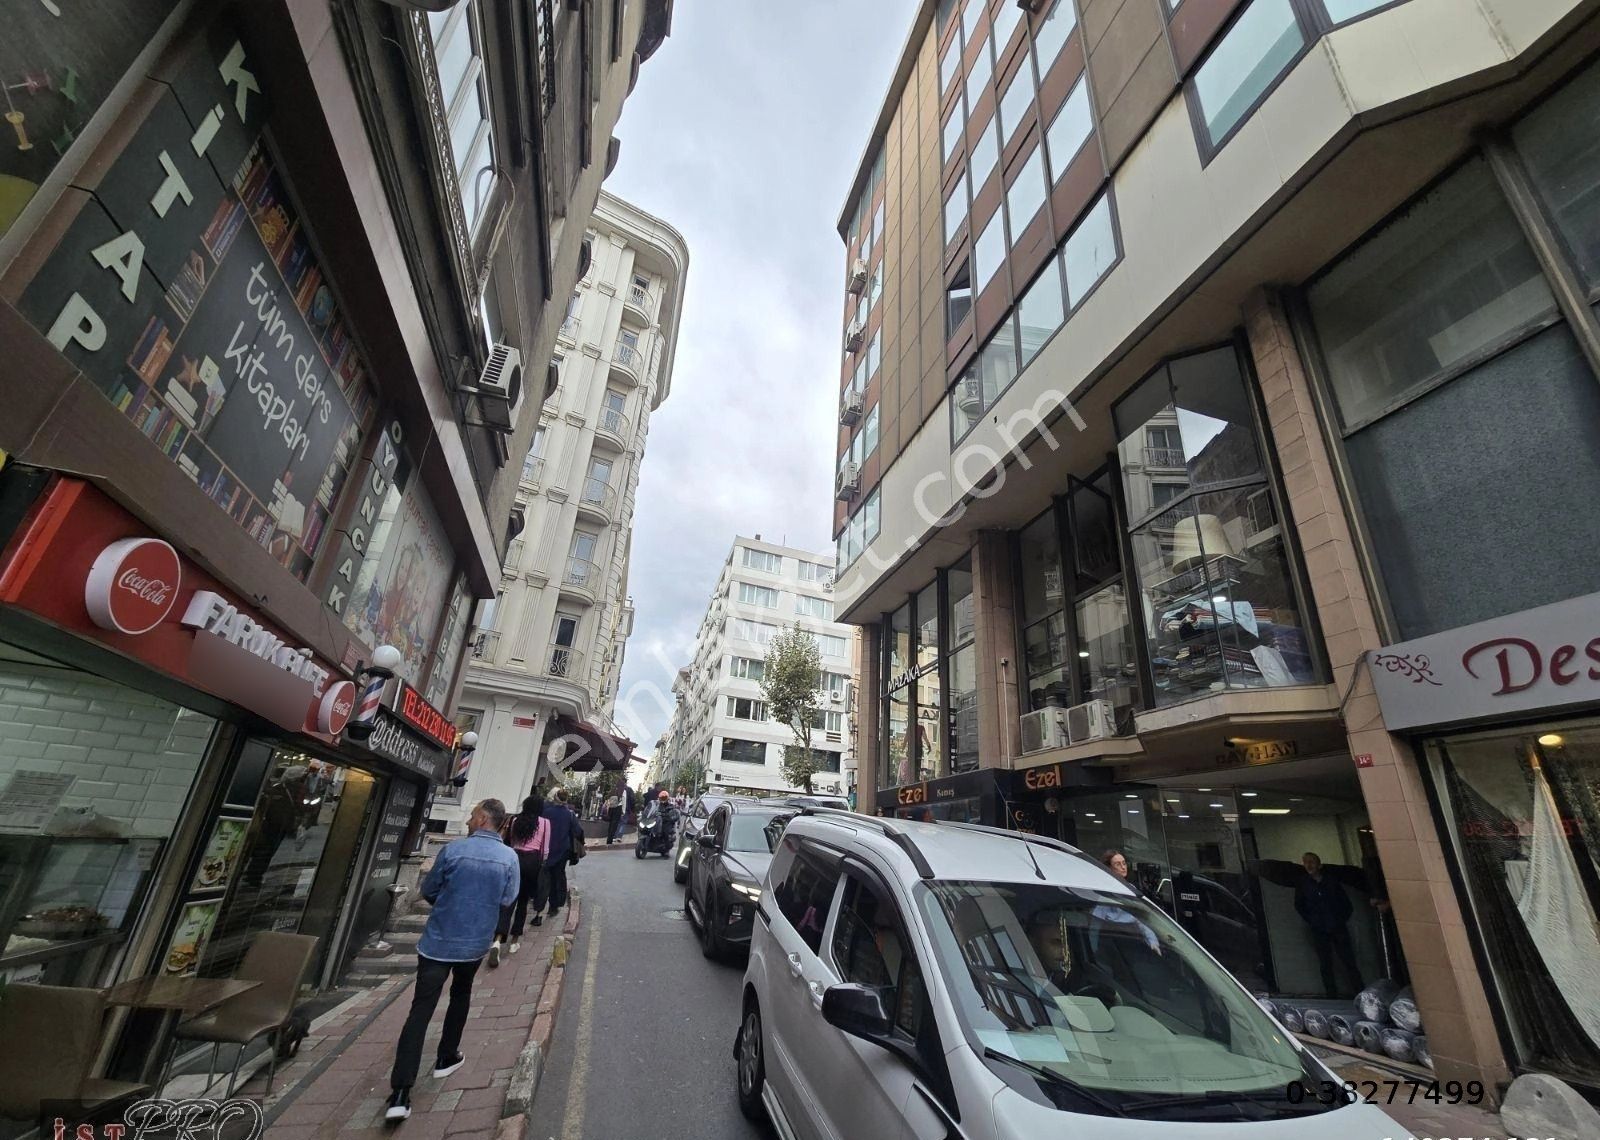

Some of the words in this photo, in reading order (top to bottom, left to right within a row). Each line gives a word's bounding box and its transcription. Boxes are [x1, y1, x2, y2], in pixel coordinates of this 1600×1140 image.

[46, 40, 261, 352] KİTAP
[224, 320, 310, 462] kitapları
[246, 261, 295, 362] tüm
[295, 354, 332, 424] ders
[328, 420, 402, 614] OYUNCAK
[887, 663, 921, 693] MAZAKA
[898, 781, 928, 805] Ezel
[1025, 764, 1062, 791] Ezel
